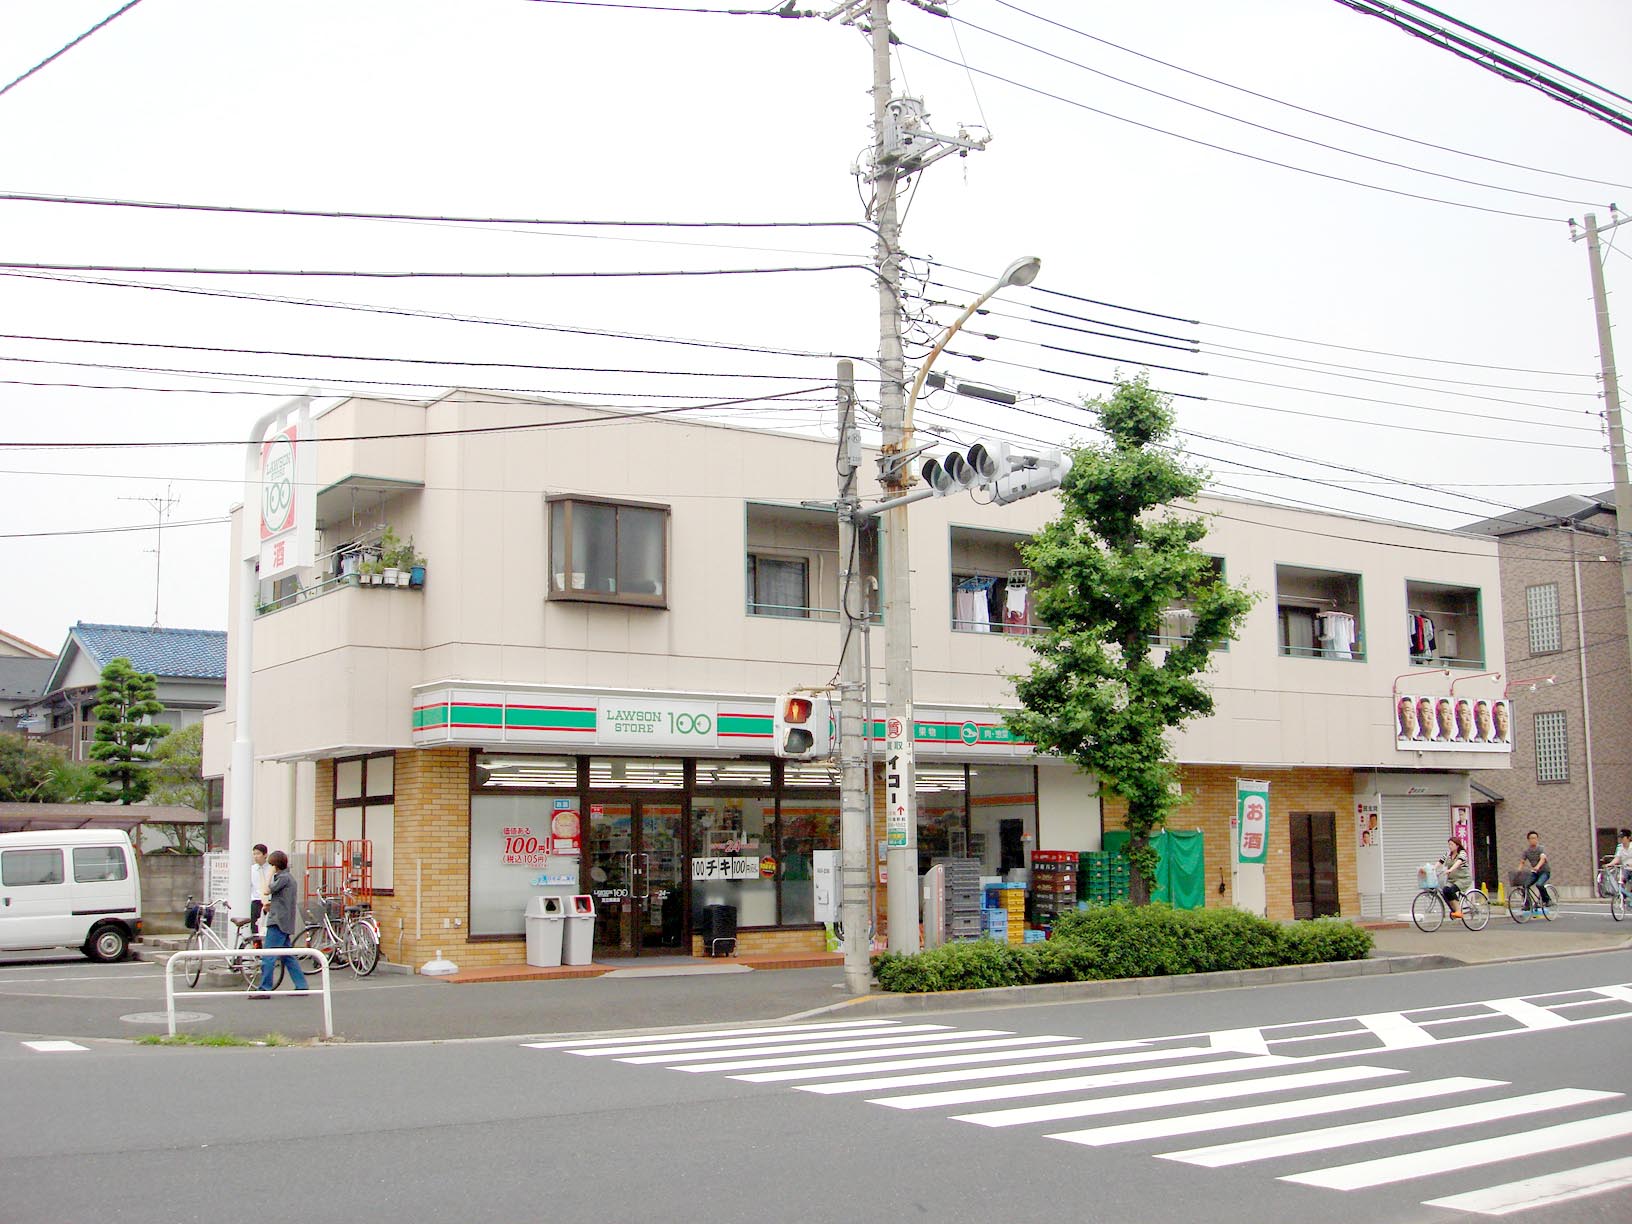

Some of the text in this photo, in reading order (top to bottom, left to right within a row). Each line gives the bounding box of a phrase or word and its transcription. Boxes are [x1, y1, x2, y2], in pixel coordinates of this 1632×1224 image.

[266, 451, 291, 475] LAWSON
[264, 478, 291, 517] 100
[273, 540, 285, 568] 酒
[607, 709, 712, 735] LAWSON 100
[615, 723, 654, 733] STORE
[503, 827, 531, 836] 価値ある
[1243, 803, 1263, 850] お酒
[613, 888, 629, 896] 100
